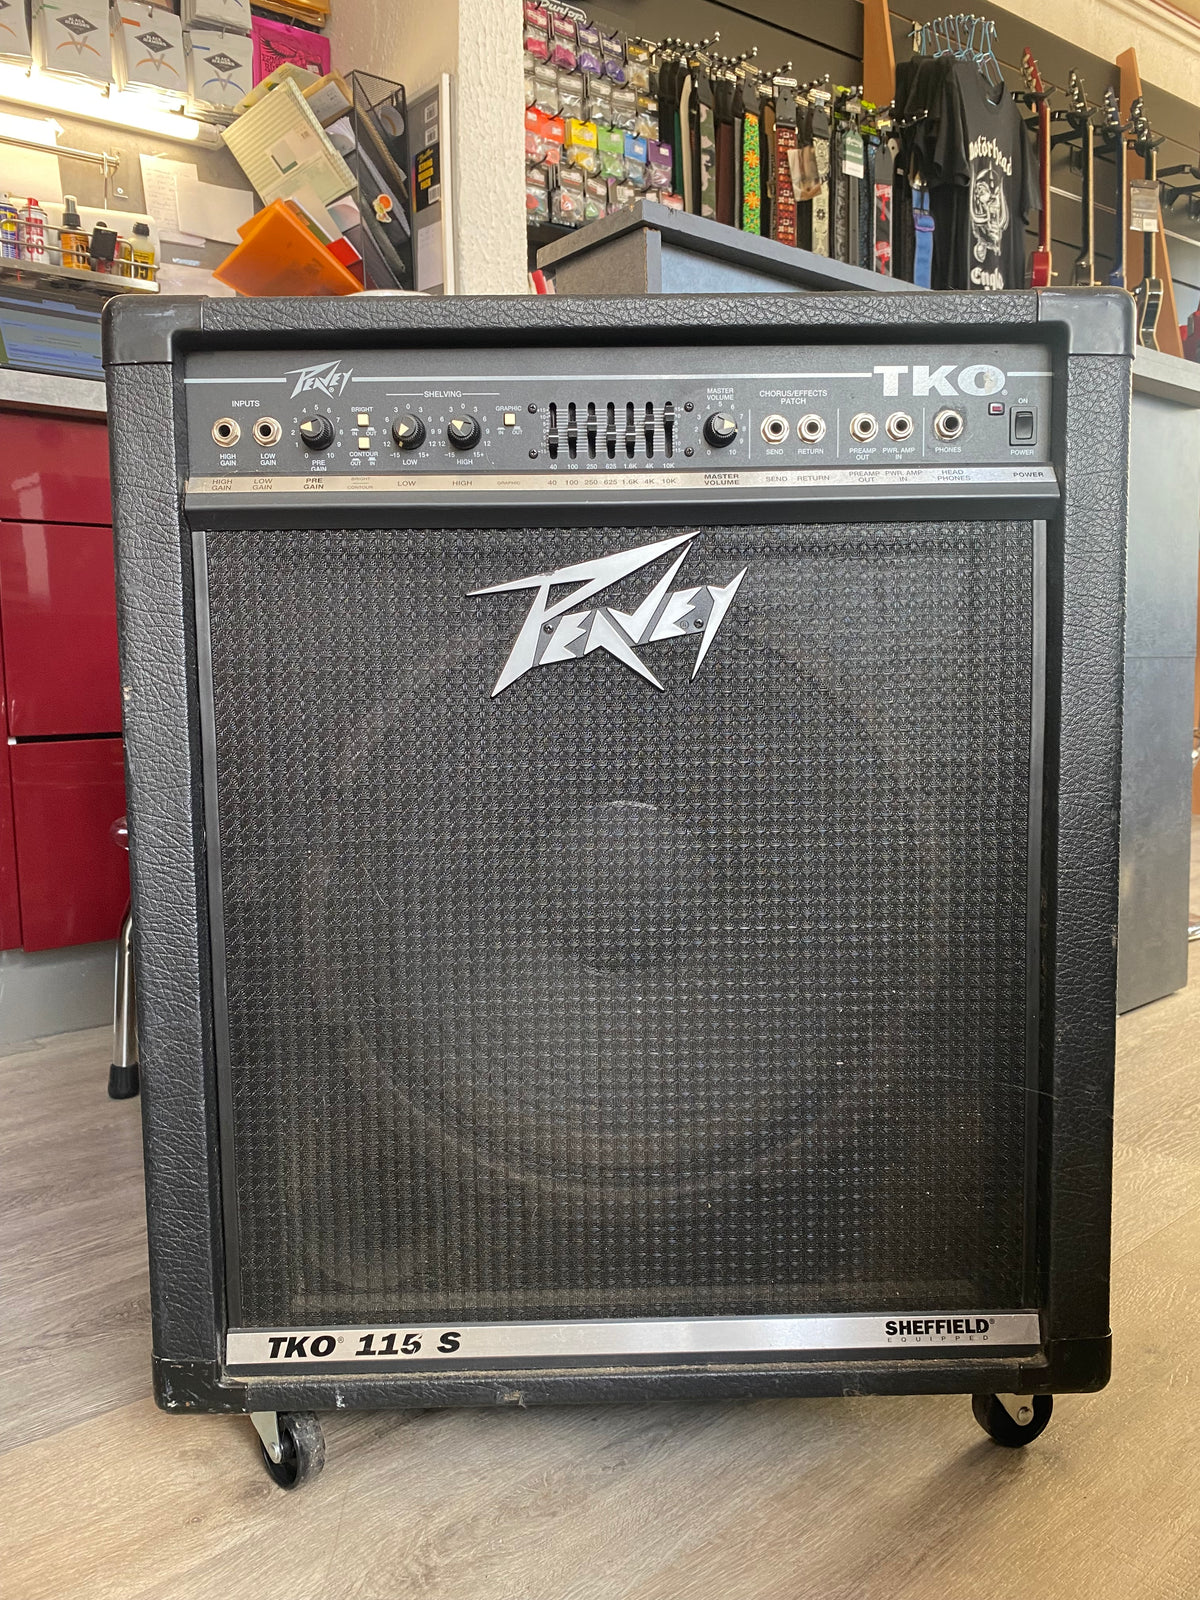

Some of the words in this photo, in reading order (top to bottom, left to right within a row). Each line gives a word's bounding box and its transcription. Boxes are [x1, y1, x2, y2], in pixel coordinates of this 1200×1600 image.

[540, 0, 585, 22] Dunlop
[284, 360, 353, 399] PEAVEY
[465, 530, 748, 698] PEAVEY
[885, 1318, 990, 1335] SHEFFIELD
[355, 1333, 422, 1356] 115
[436, 1332, 462, 1354] S
